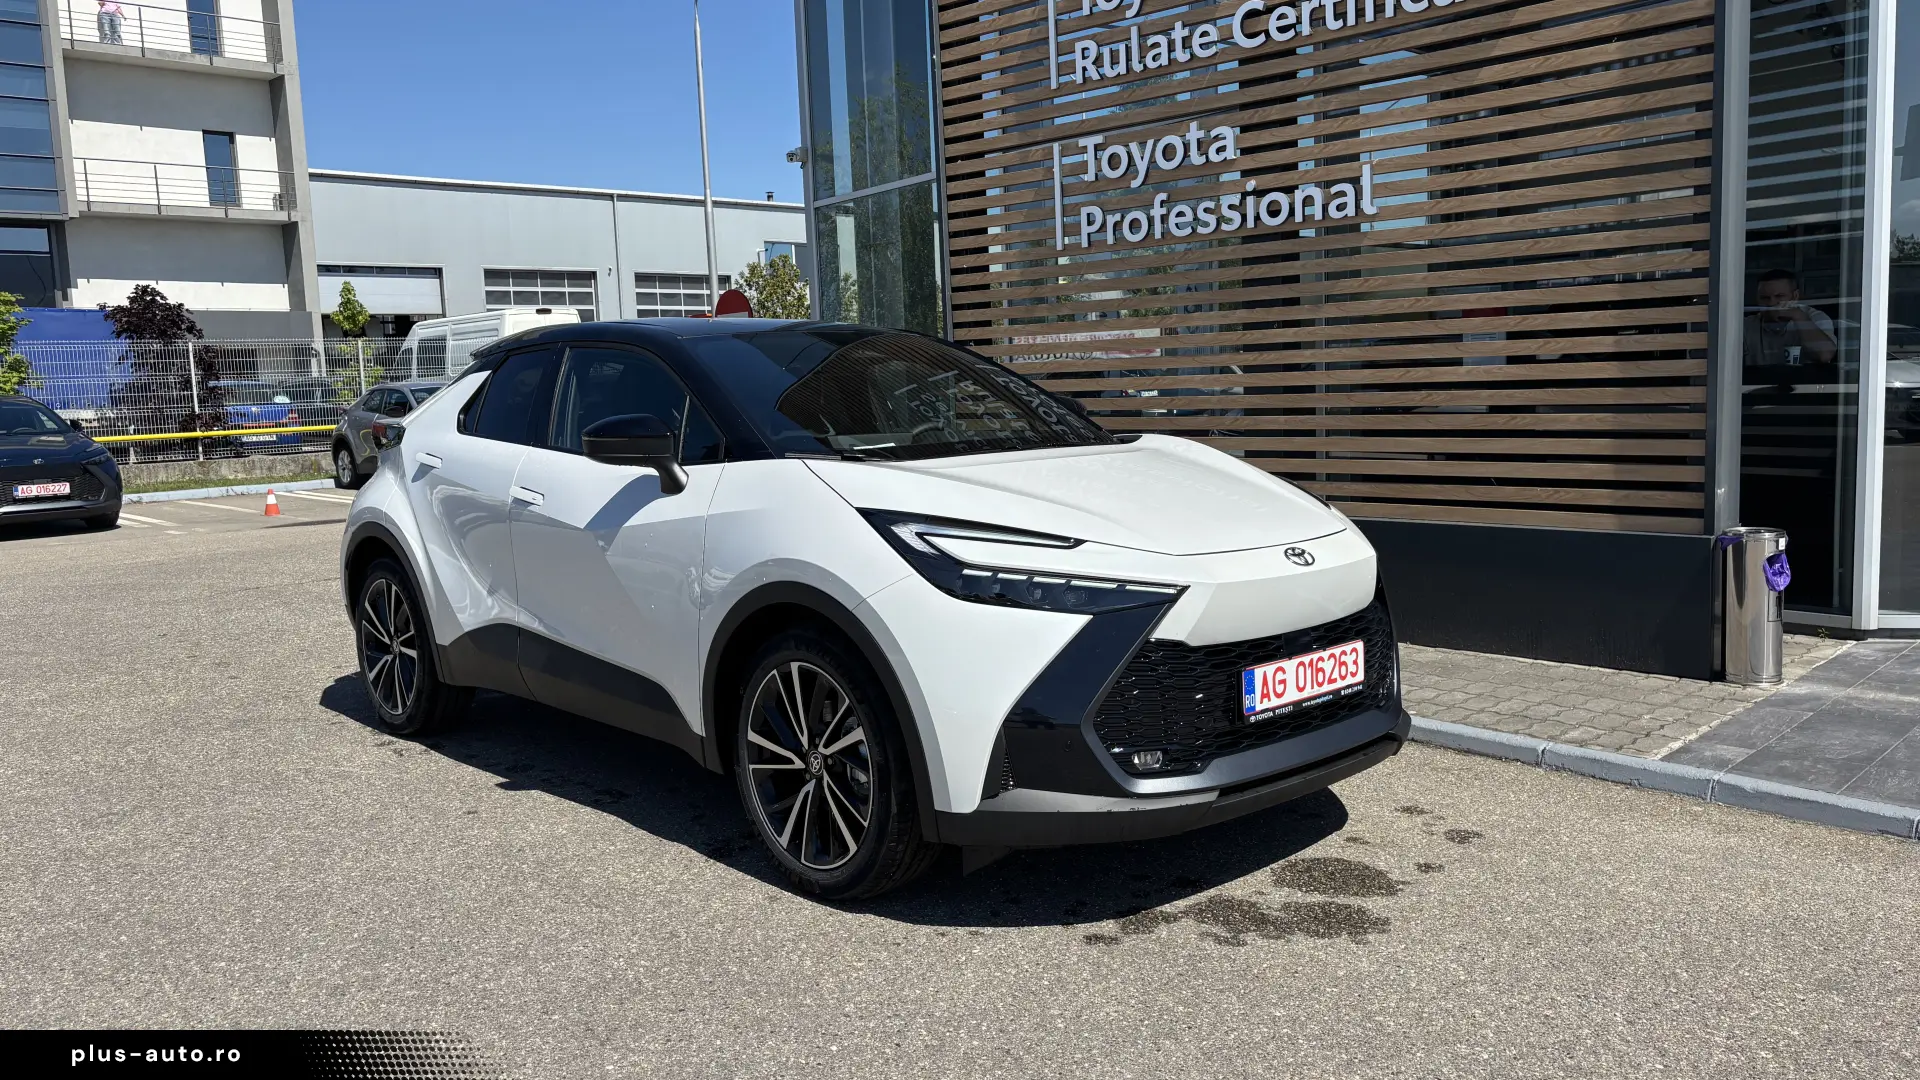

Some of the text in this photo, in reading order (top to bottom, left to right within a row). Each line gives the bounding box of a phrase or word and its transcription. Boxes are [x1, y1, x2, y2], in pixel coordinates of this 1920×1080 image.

[1075, 20, 1219, 84] Rulate
[1078, 121, 1236, 188] Toyota
[1080, 163, 1378, 248] Professional
[20, 486, 33, 495] AG
[36, 484, 67, 494] 016227
[1245, 694, 1255, 708] RO
[1260, 647, 1359, 704] AG 016263
